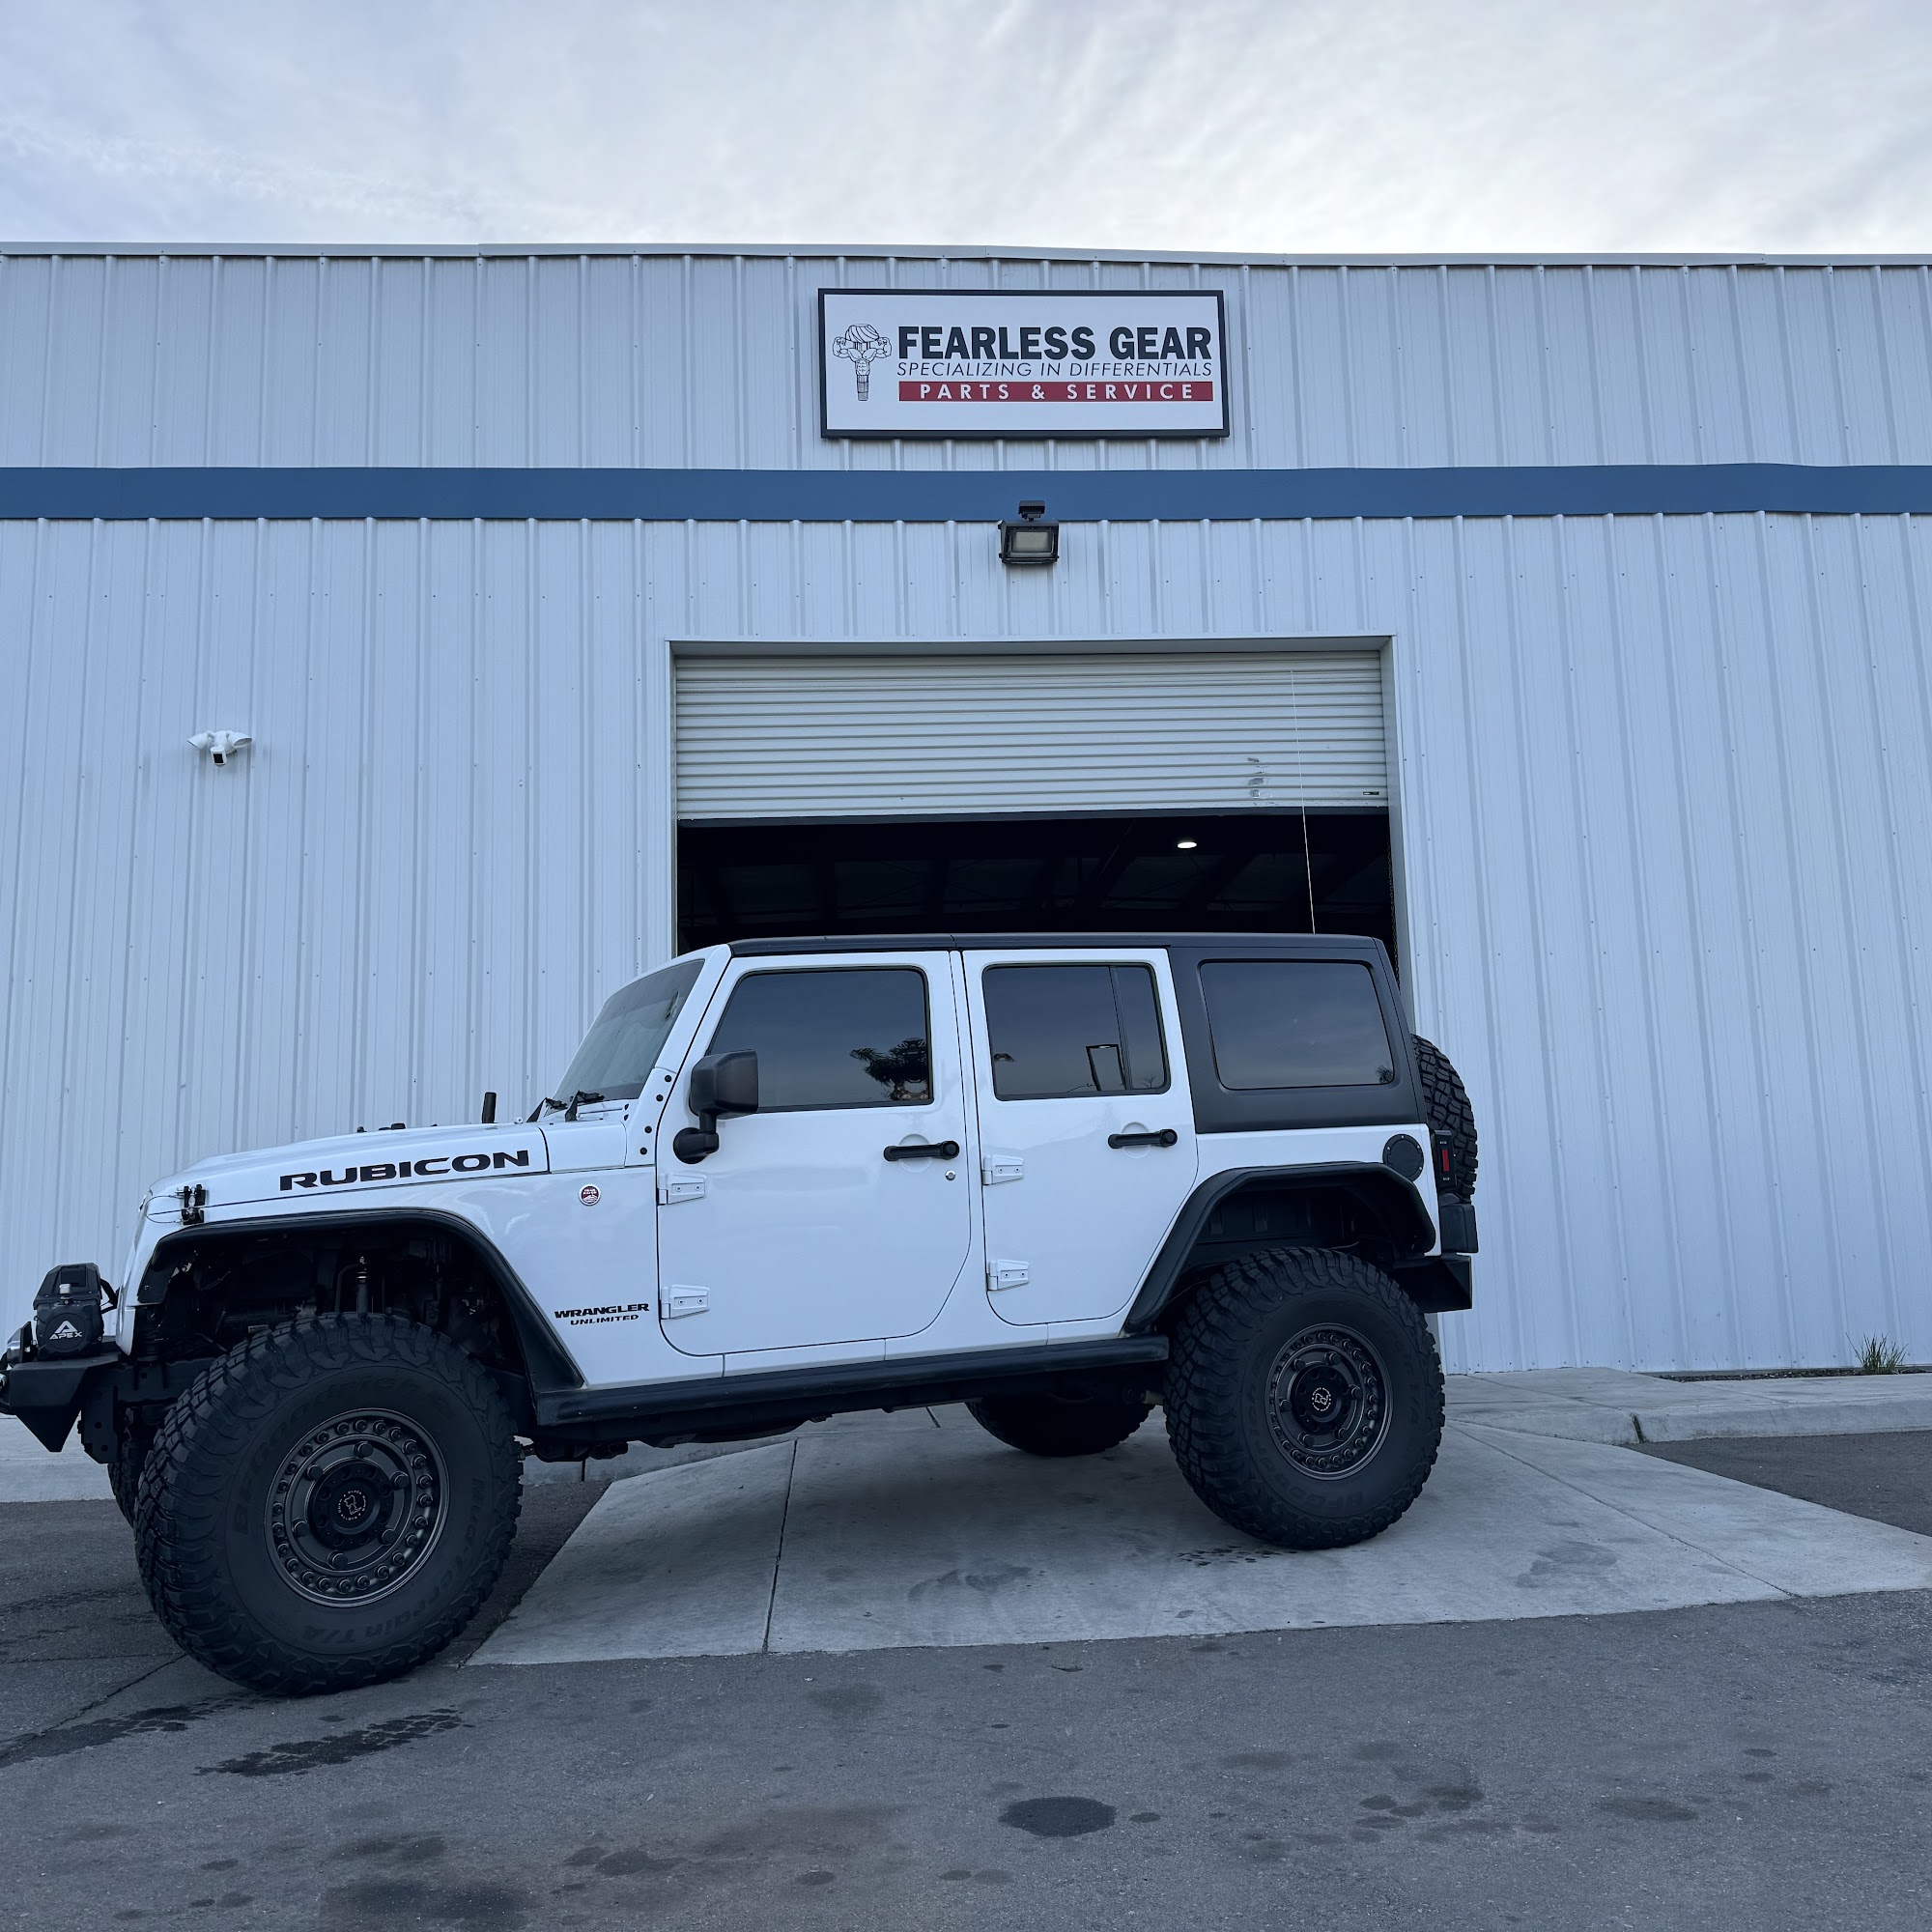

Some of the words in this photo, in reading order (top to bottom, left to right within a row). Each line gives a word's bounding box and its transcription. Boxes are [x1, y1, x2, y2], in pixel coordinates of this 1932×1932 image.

[898, 327, 1095, 360] FEARLESS
[1109, 327, 1211, 360] GEAR
[896, 362, 1033, 377] SPECIALIZING
[1040, 362, 1061, 377] IN
[1069, 362, 1212, 377] DIFFERENTIALS
[920, 384, 1009, 400] PARTS
[1031, 384, 1045, 400] &
[1066, 384, 1192, 400] SERVICE
[279, 1151, 530, 1192] RUBICON
[554, 1303, 650, 1320] WRANGLER
[570, 1315, 639, 1326] UNLIMITED
[49, 1331, 83, 1340] APEX
